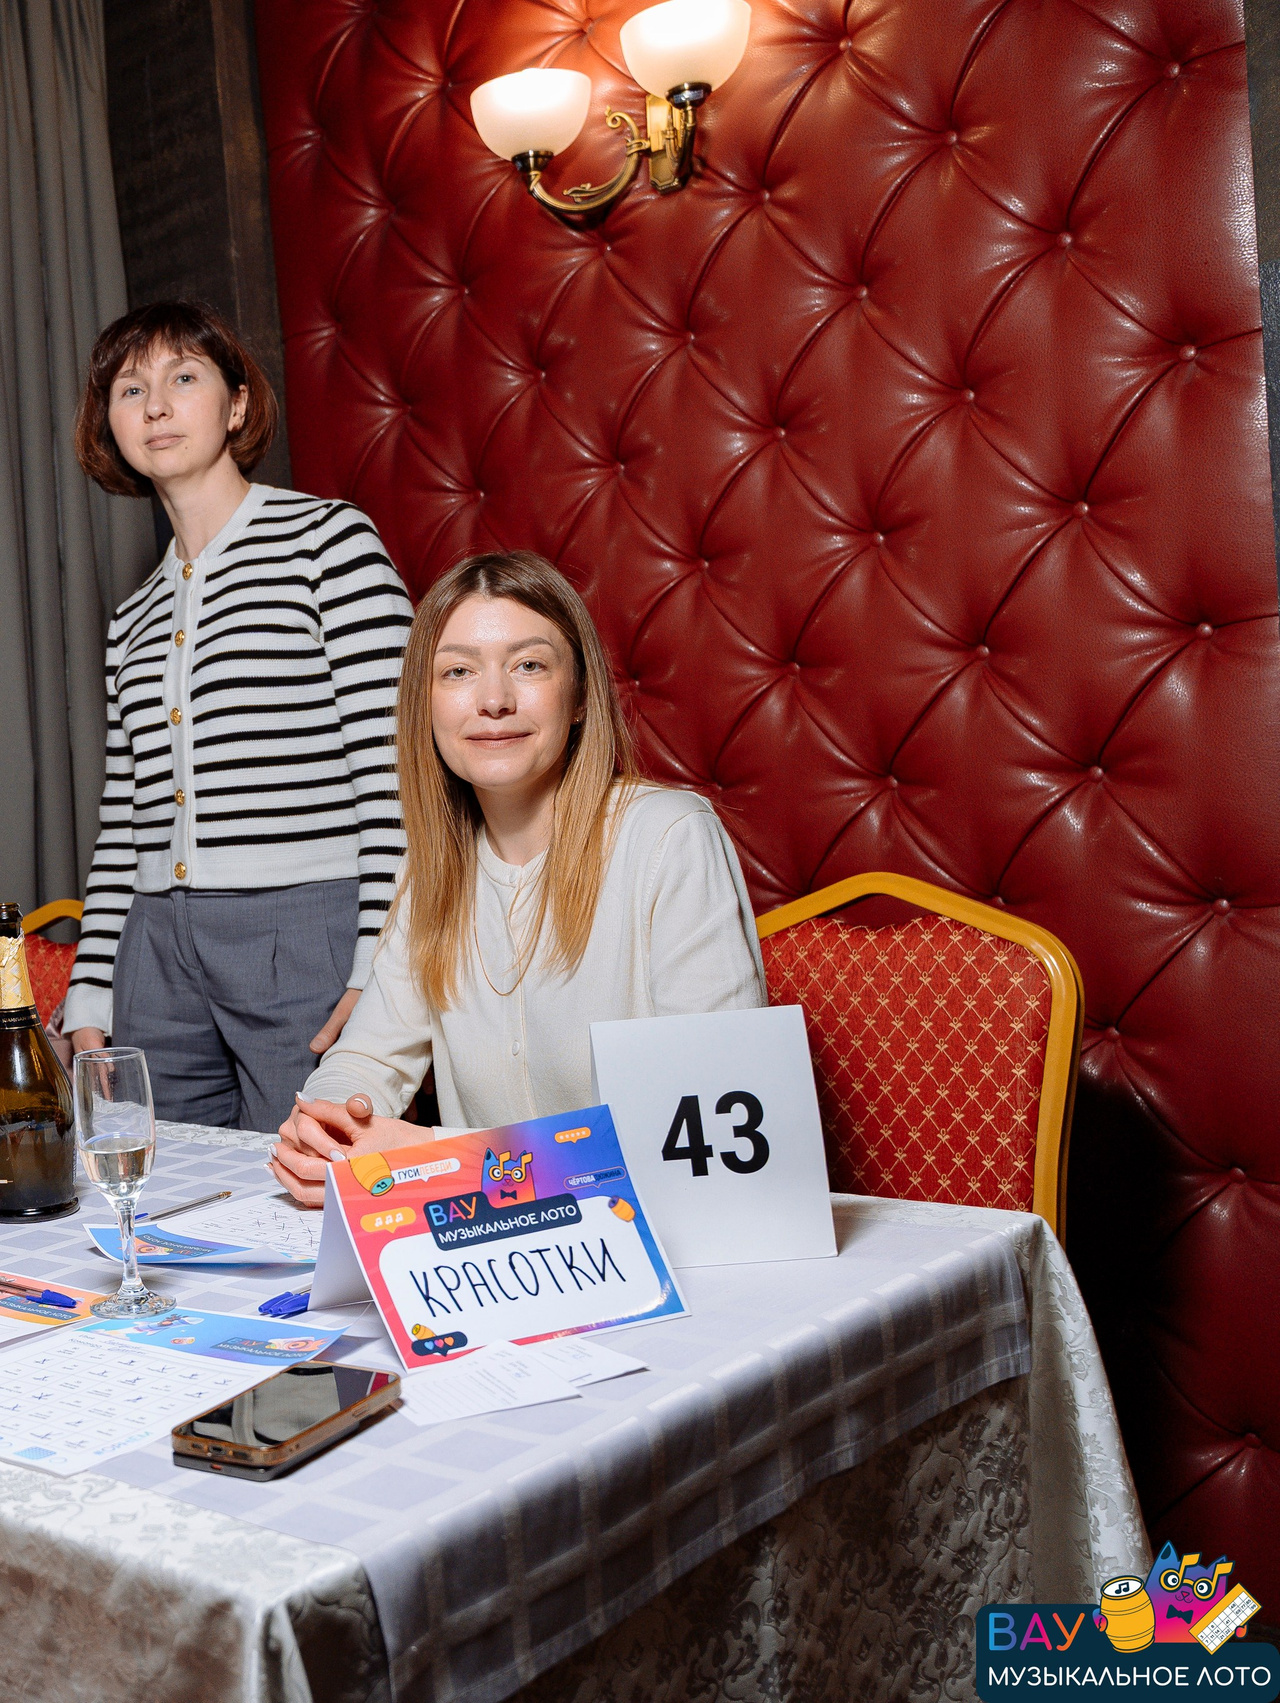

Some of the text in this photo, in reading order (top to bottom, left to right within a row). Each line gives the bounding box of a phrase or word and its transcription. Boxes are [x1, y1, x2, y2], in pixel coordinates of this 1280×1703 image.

[661, 1090, 771, 1177] 43
[428, 1196, 477, 1227] ВАУ
[438, 1204, 577, 1245] МУЗЫКАЛЬНОЕ ЛОТО
[409, 1237, 627, 1318] КРАСОТКИ
